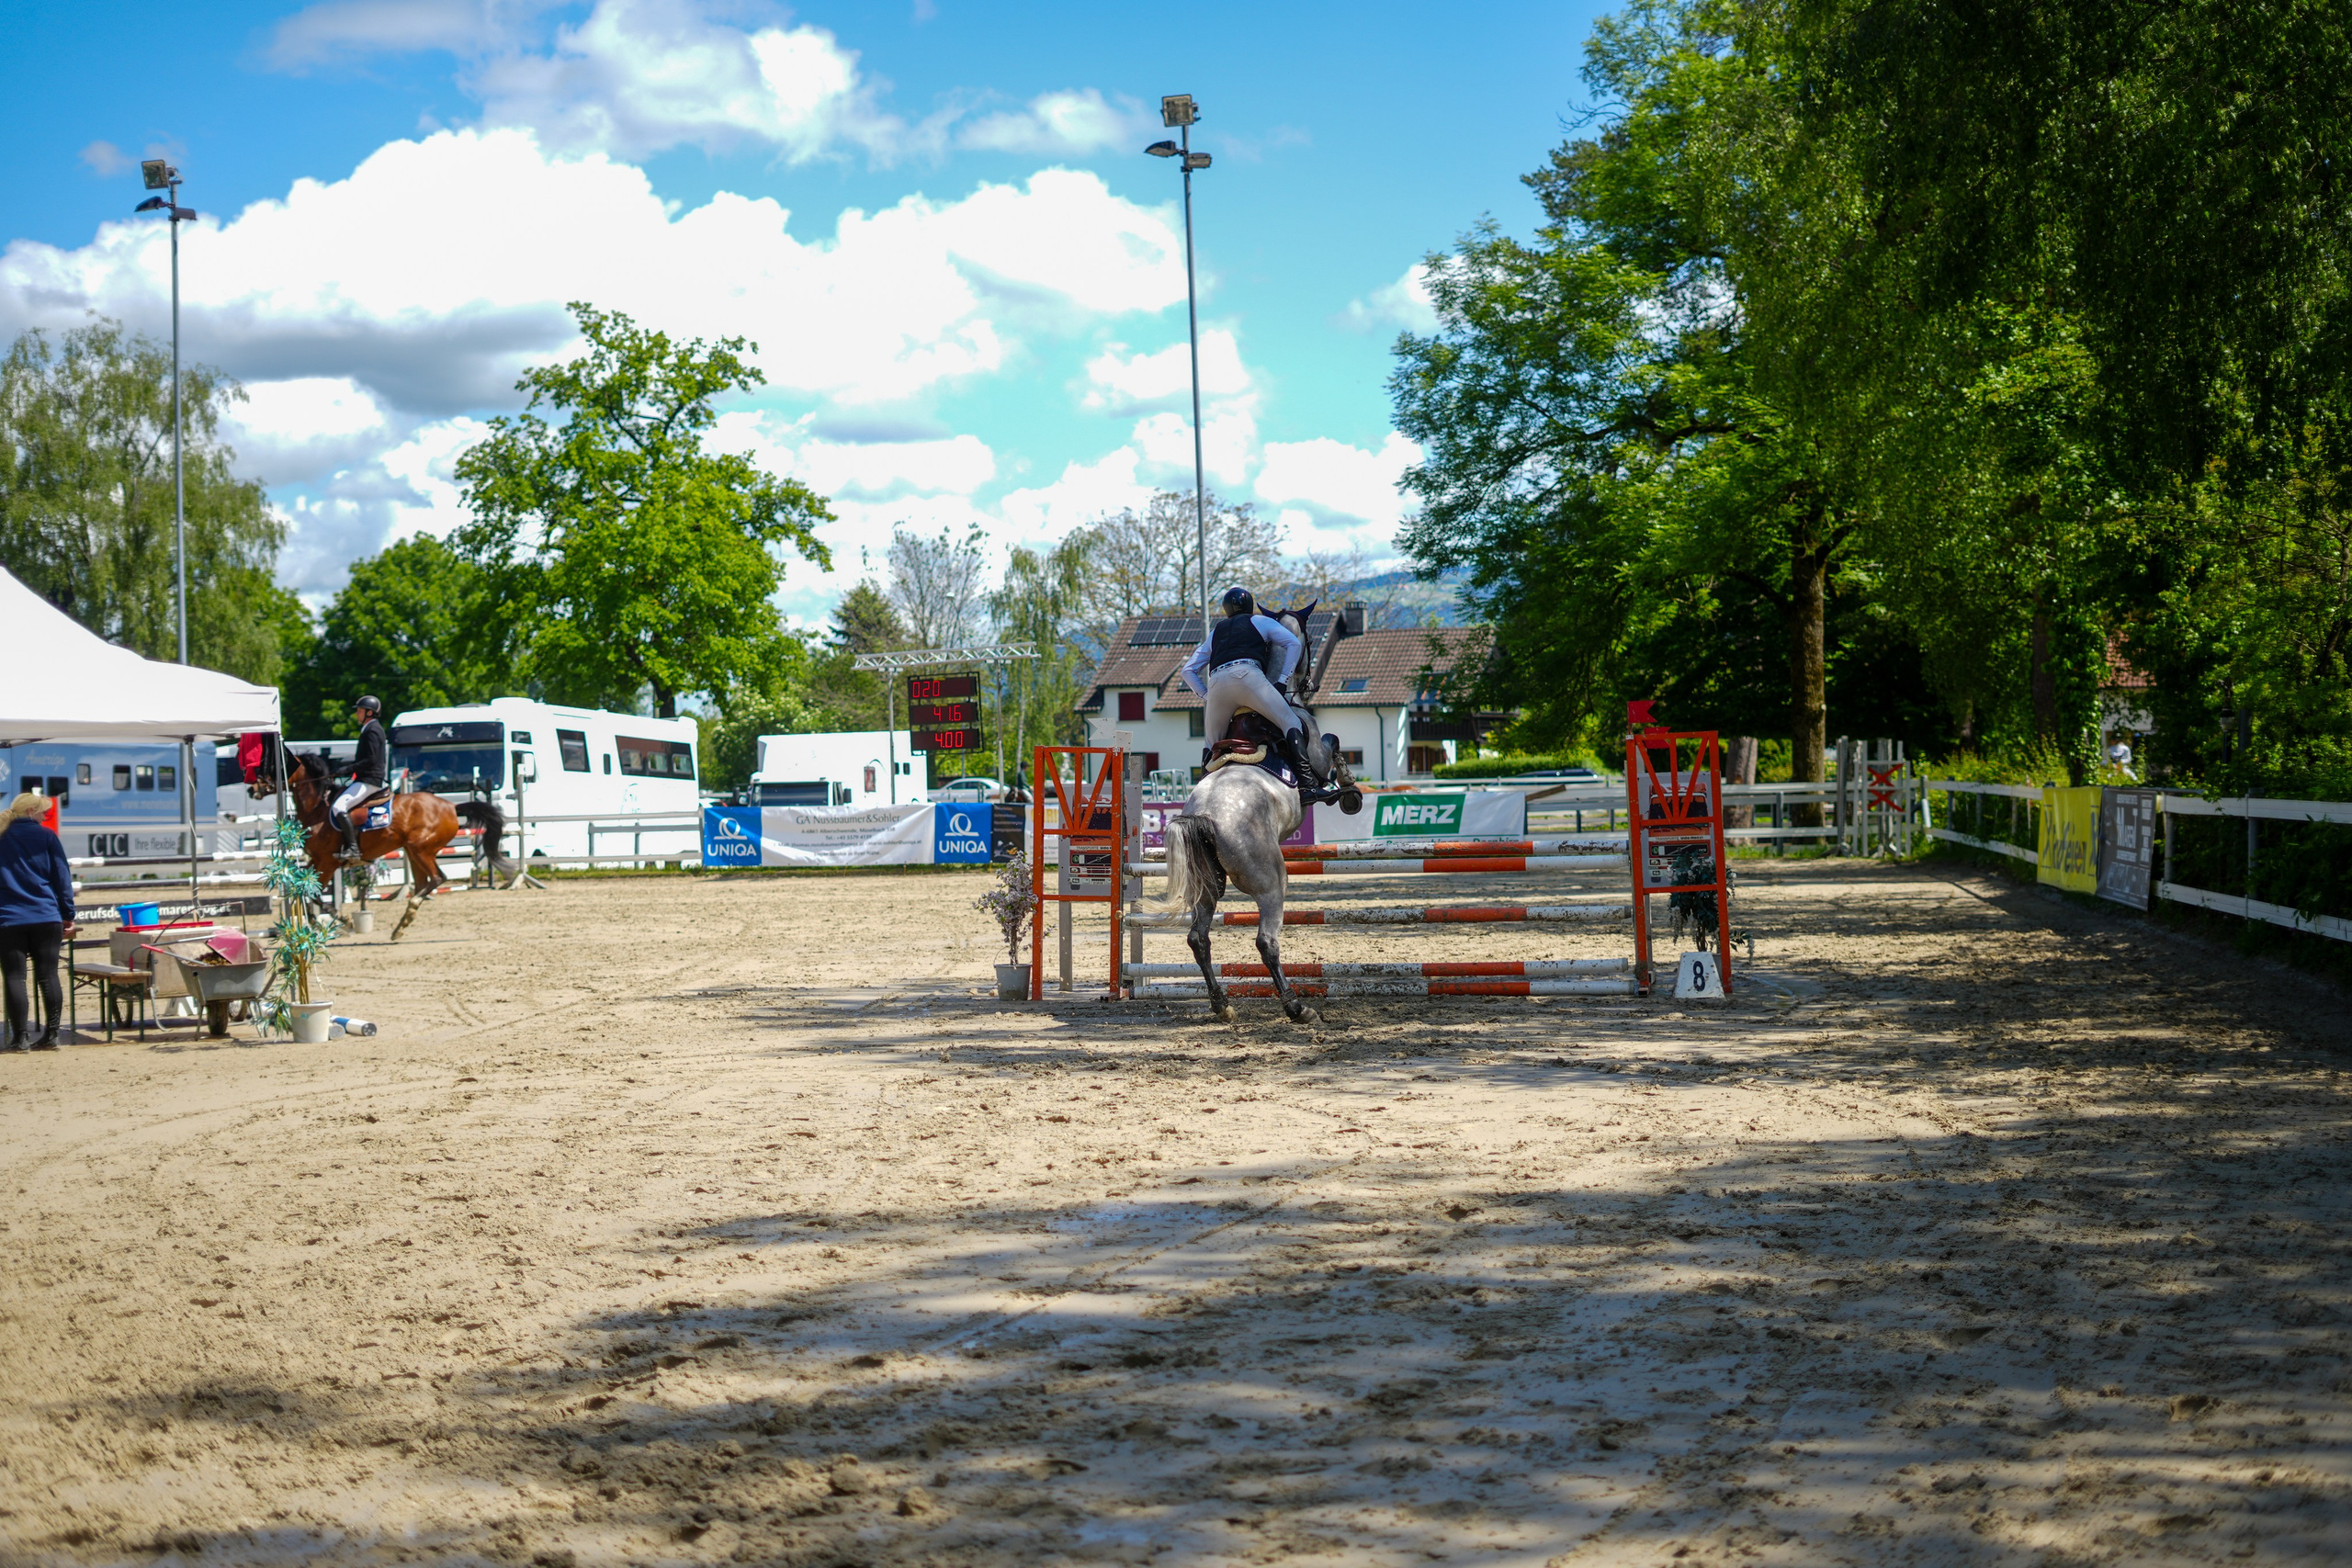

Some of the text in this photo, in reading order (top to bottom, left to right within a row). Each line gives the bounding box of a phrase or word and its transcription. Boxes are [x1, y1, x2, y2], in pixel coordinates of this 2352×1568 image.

[912, 680, 941, 698] 020
[934, 730, 964, 749] 4.00
[796, 813, 900, 825] GA Nussbaumer&Sohler
[1380, 804, 1457, 826] MERZ
[92, 833, 126, 856] CIC
[134, 836, 176, 851] Ihre flexible
[707, 843, 758, 857] UNIQA
[938, 840, 988, 854] UNIQA
[1692, 960, 1706, 992] 8
